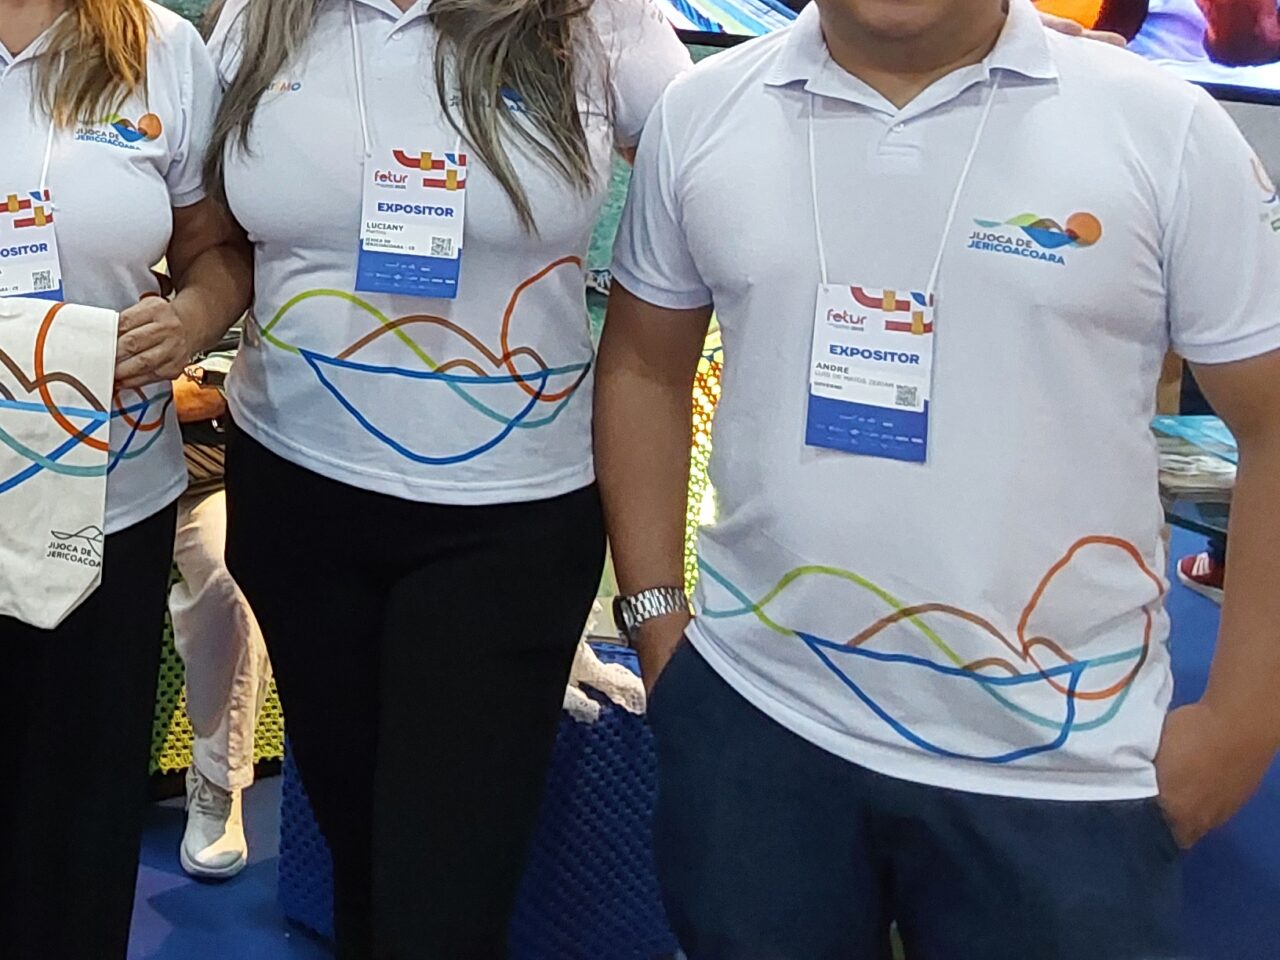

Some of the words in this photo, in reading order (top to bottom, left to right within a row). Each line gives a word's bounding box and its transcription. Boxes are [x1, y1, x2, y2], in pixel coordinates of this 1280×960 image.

[374, 169, 409, 184] fetur
[377, 202, 454, 218] EXPOSITOR
[969, 231, 1013, 246] JIJOCA
[1015, 237, 1033, 249] DE
[968, 240, 1066, 266] JERICOACOARA
[826, 308, 867, 326] fetur
[828, 343, 920, 365] EXPOSITOR
[48, 541, 78, 553] JIJOCA
[80, 547, 92, 557] DE
